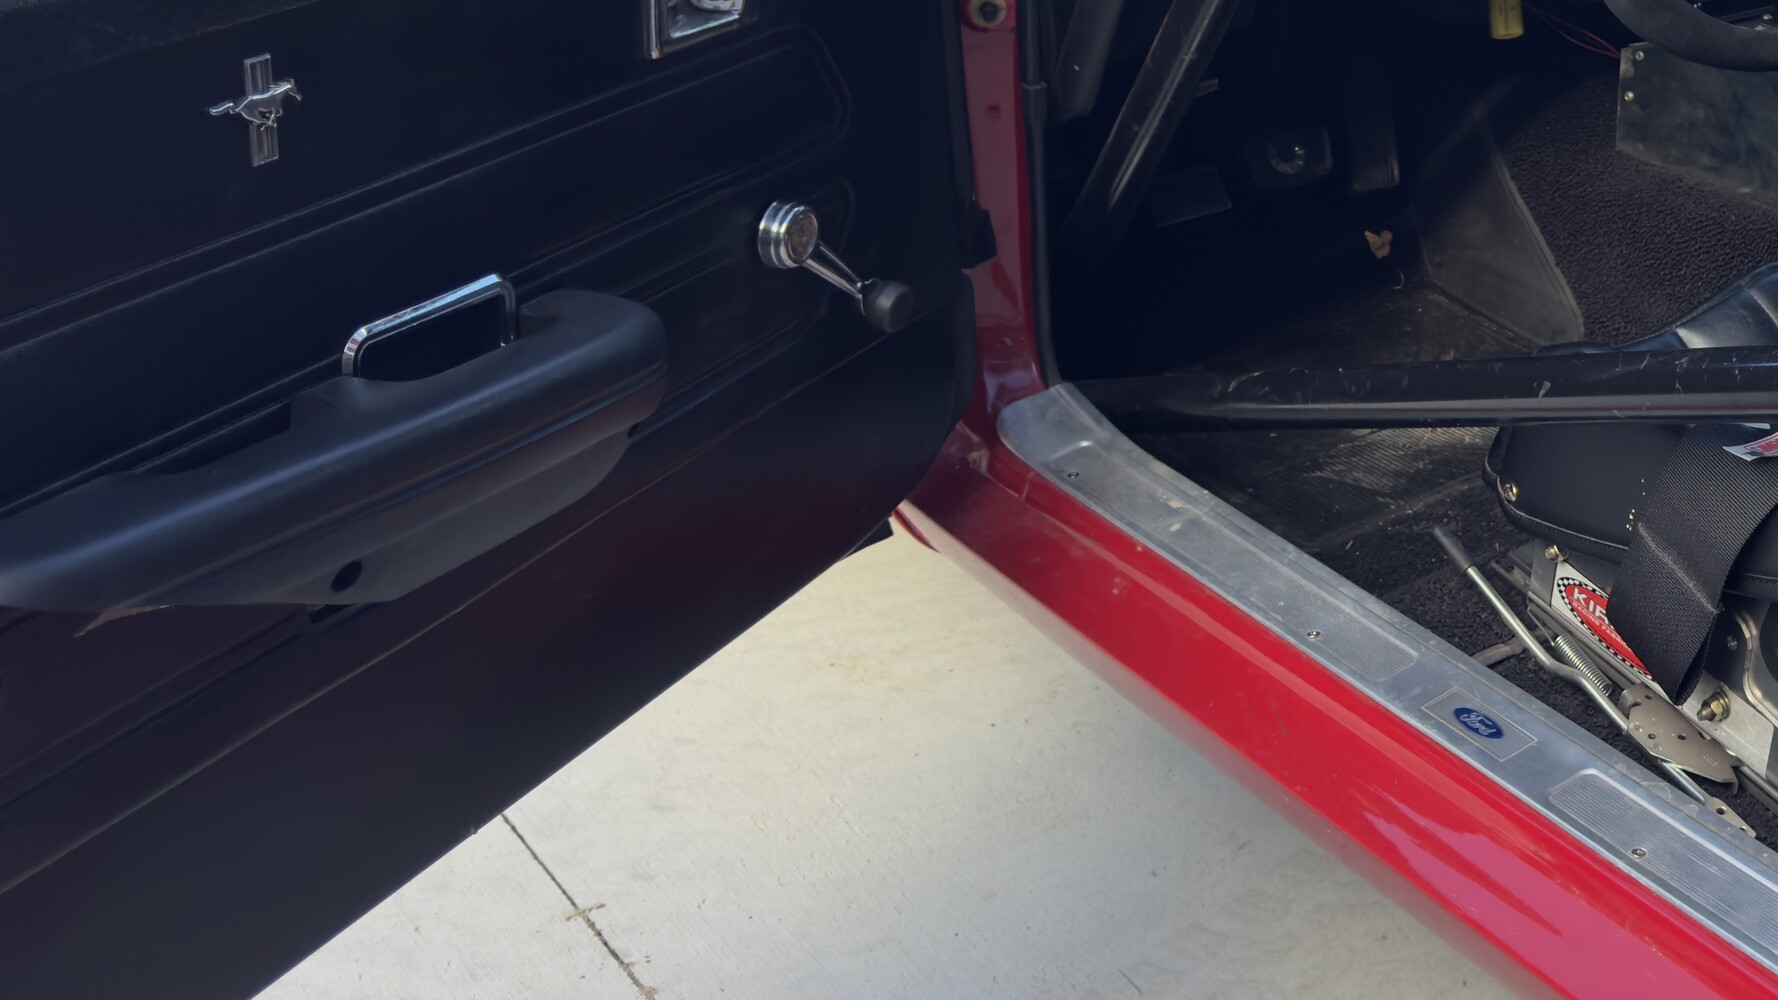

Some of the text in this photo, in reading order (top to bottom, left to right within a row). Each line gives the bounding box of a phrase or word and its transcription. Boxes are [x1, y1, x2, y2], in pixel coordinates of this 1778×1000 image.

[1572, 601, 1600, 626] RACING
[1573, 587, 1614, 629] KIR
[1459, 711, 1497, 736] Ford
